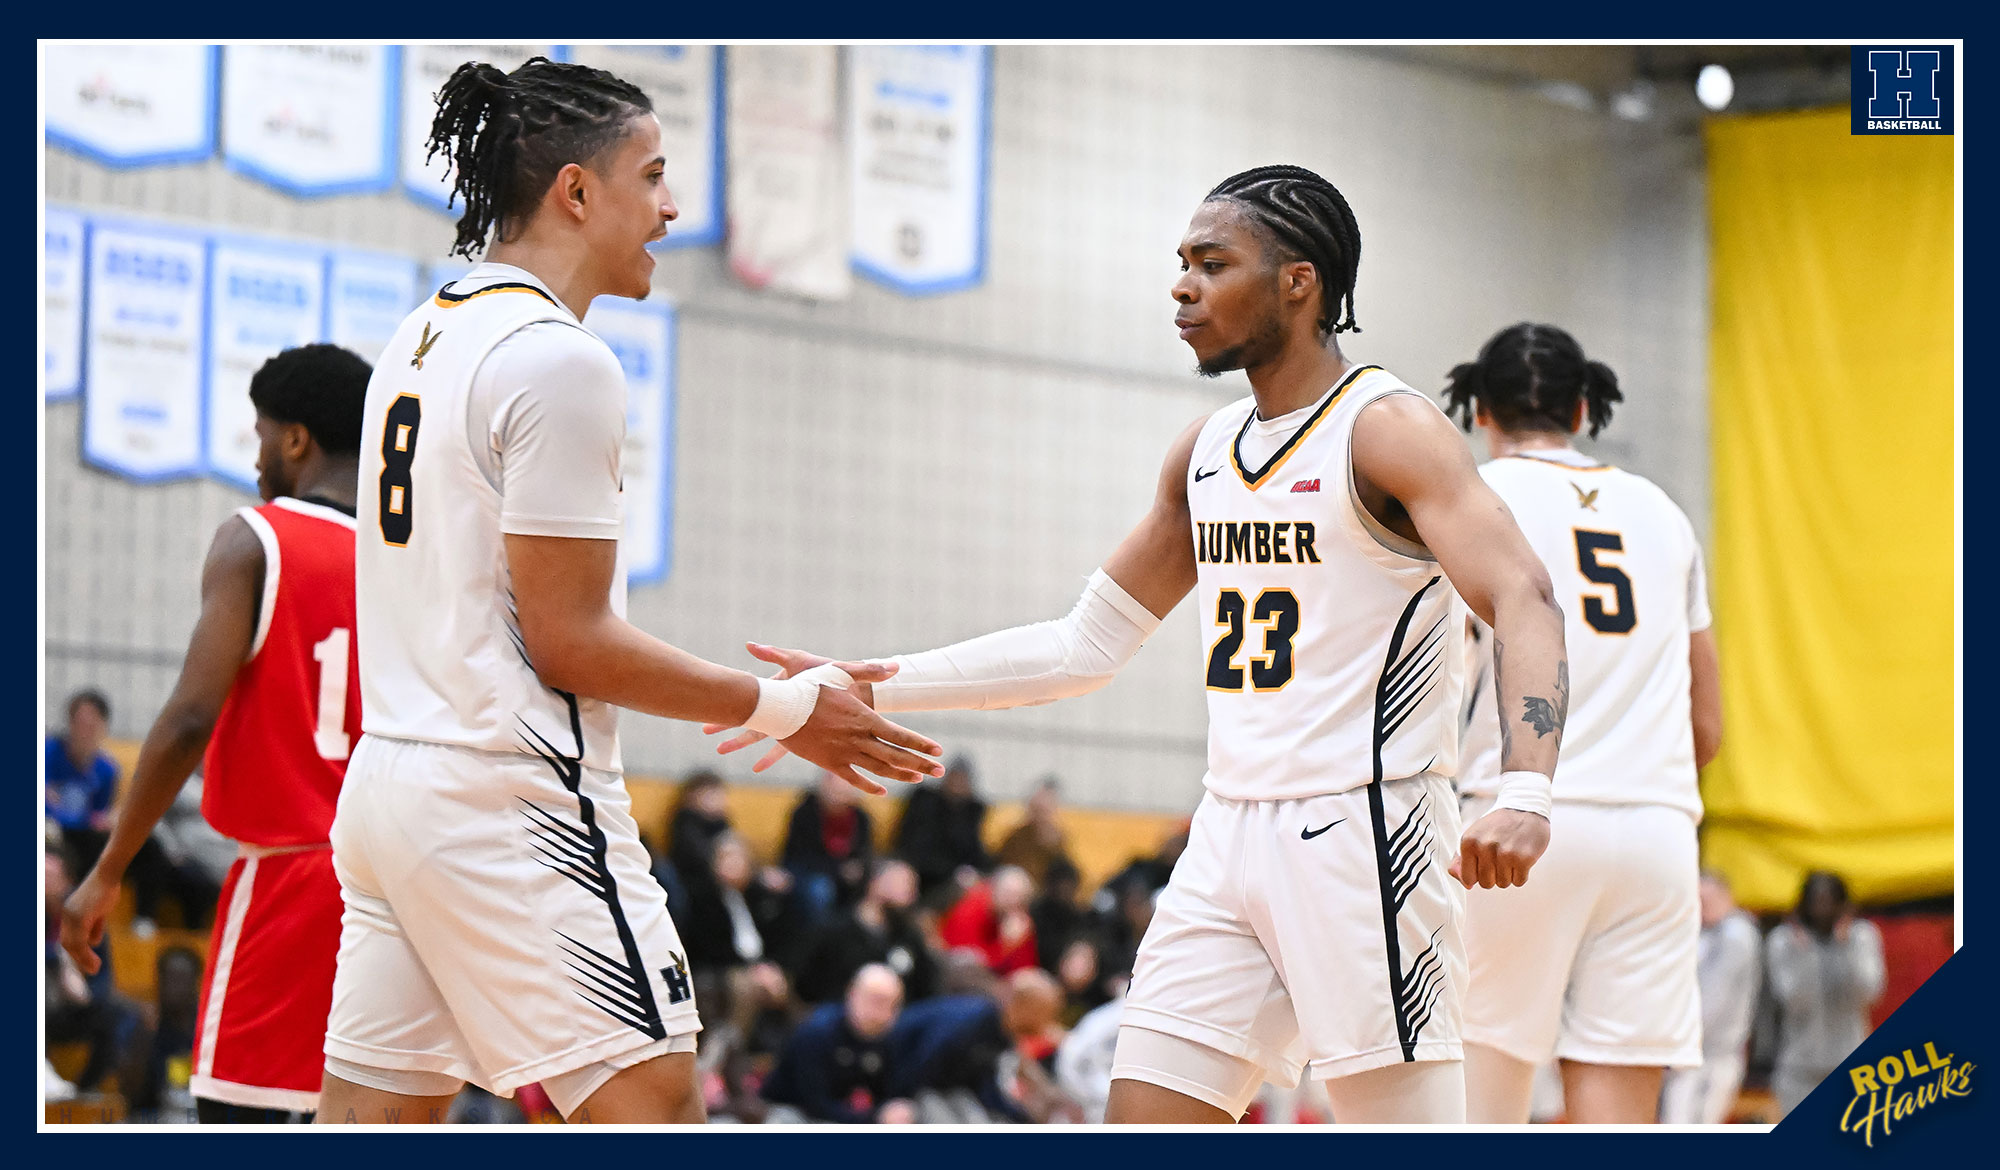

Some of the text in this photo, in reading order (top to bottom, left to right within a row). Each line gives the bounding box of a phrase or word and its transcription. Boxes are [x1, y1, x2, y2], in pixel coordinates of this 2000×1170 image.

[379, 391, 421, 548] 8
[1571, 526, 1639, 637] 5
[1205, 587, 1301, 693] 23
